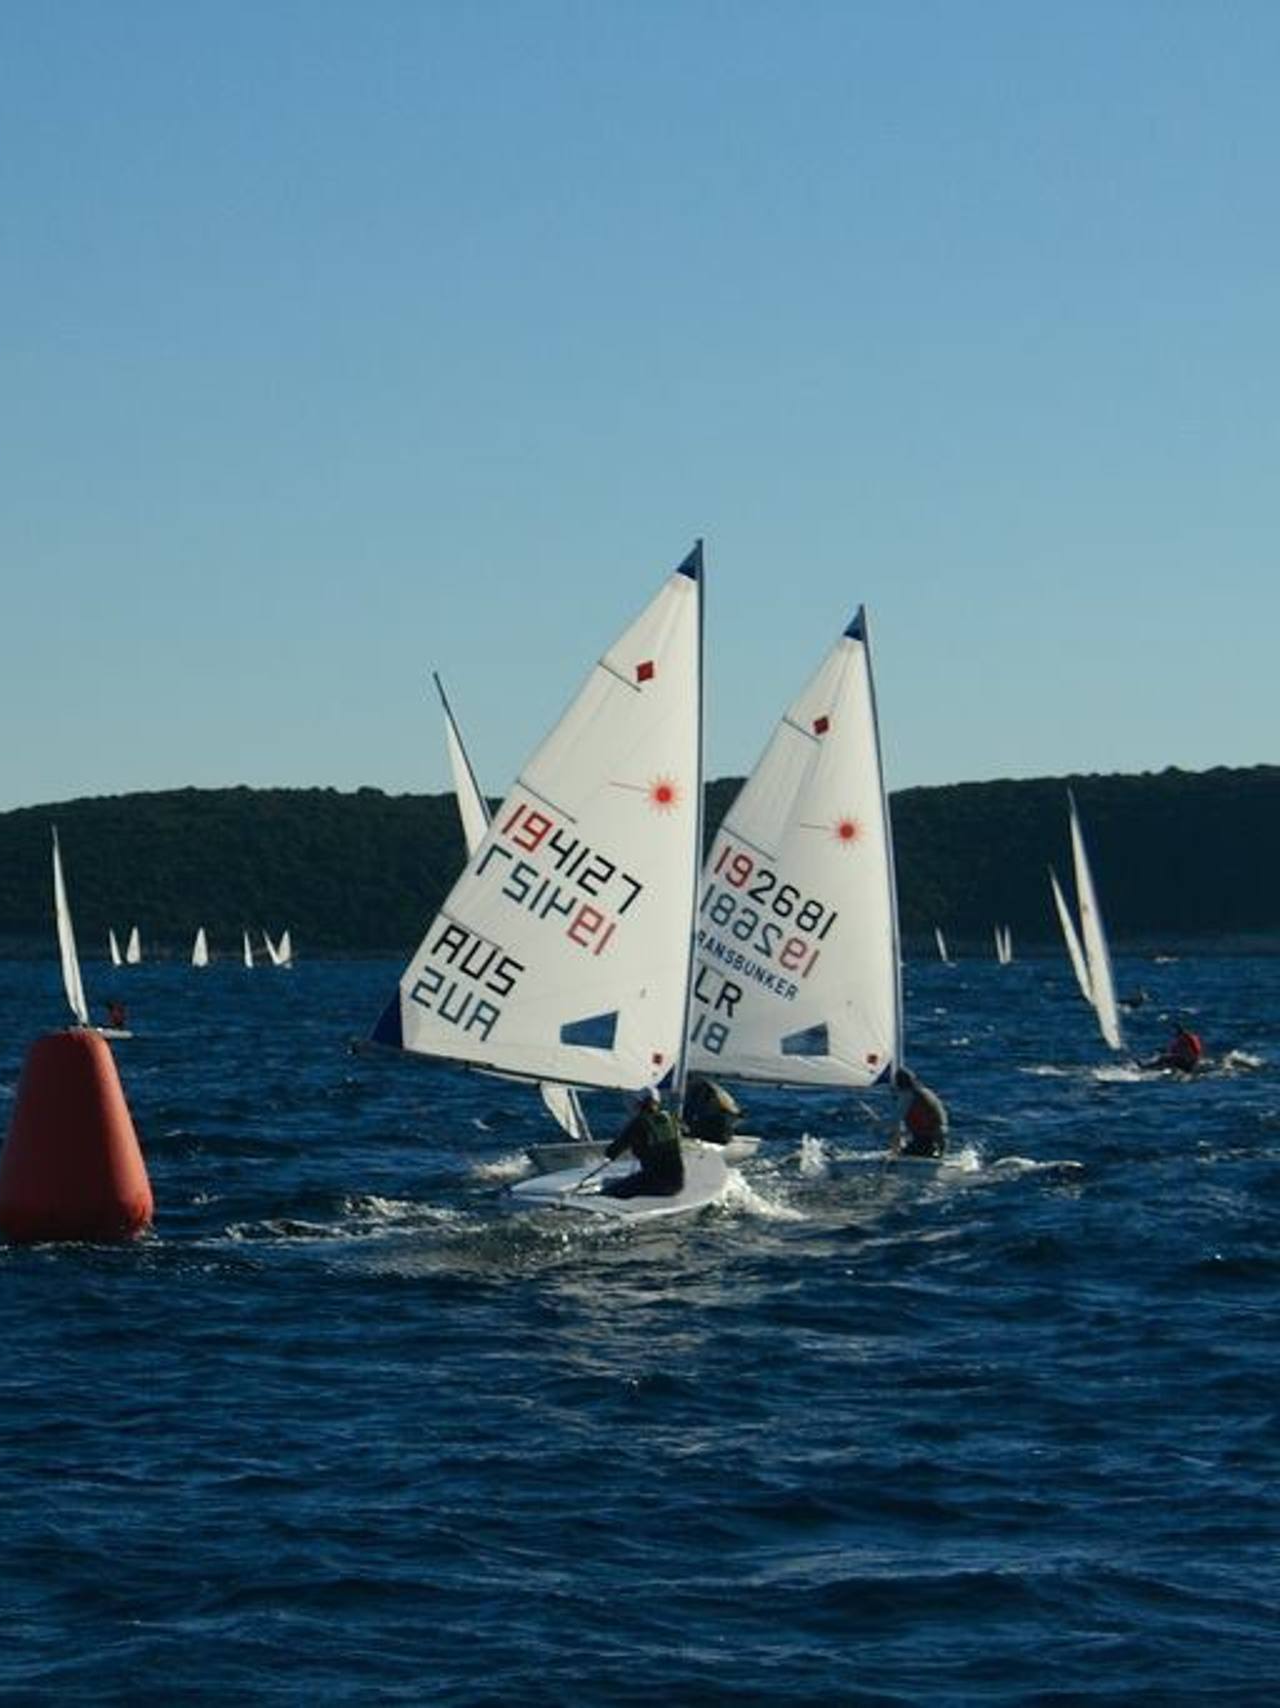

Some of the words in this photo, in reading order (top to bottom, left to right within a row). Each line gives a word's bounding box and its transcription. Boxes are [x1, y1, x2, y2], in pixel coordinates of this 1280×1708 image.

[502, 804, 643, 914] 194127
[714, 845, 838, 940] 192681
[431, 924, 525, 997] RUS
[694, 966, 743, 1018] LR
[697, 930, 799, 1000] RANSBUNKER
